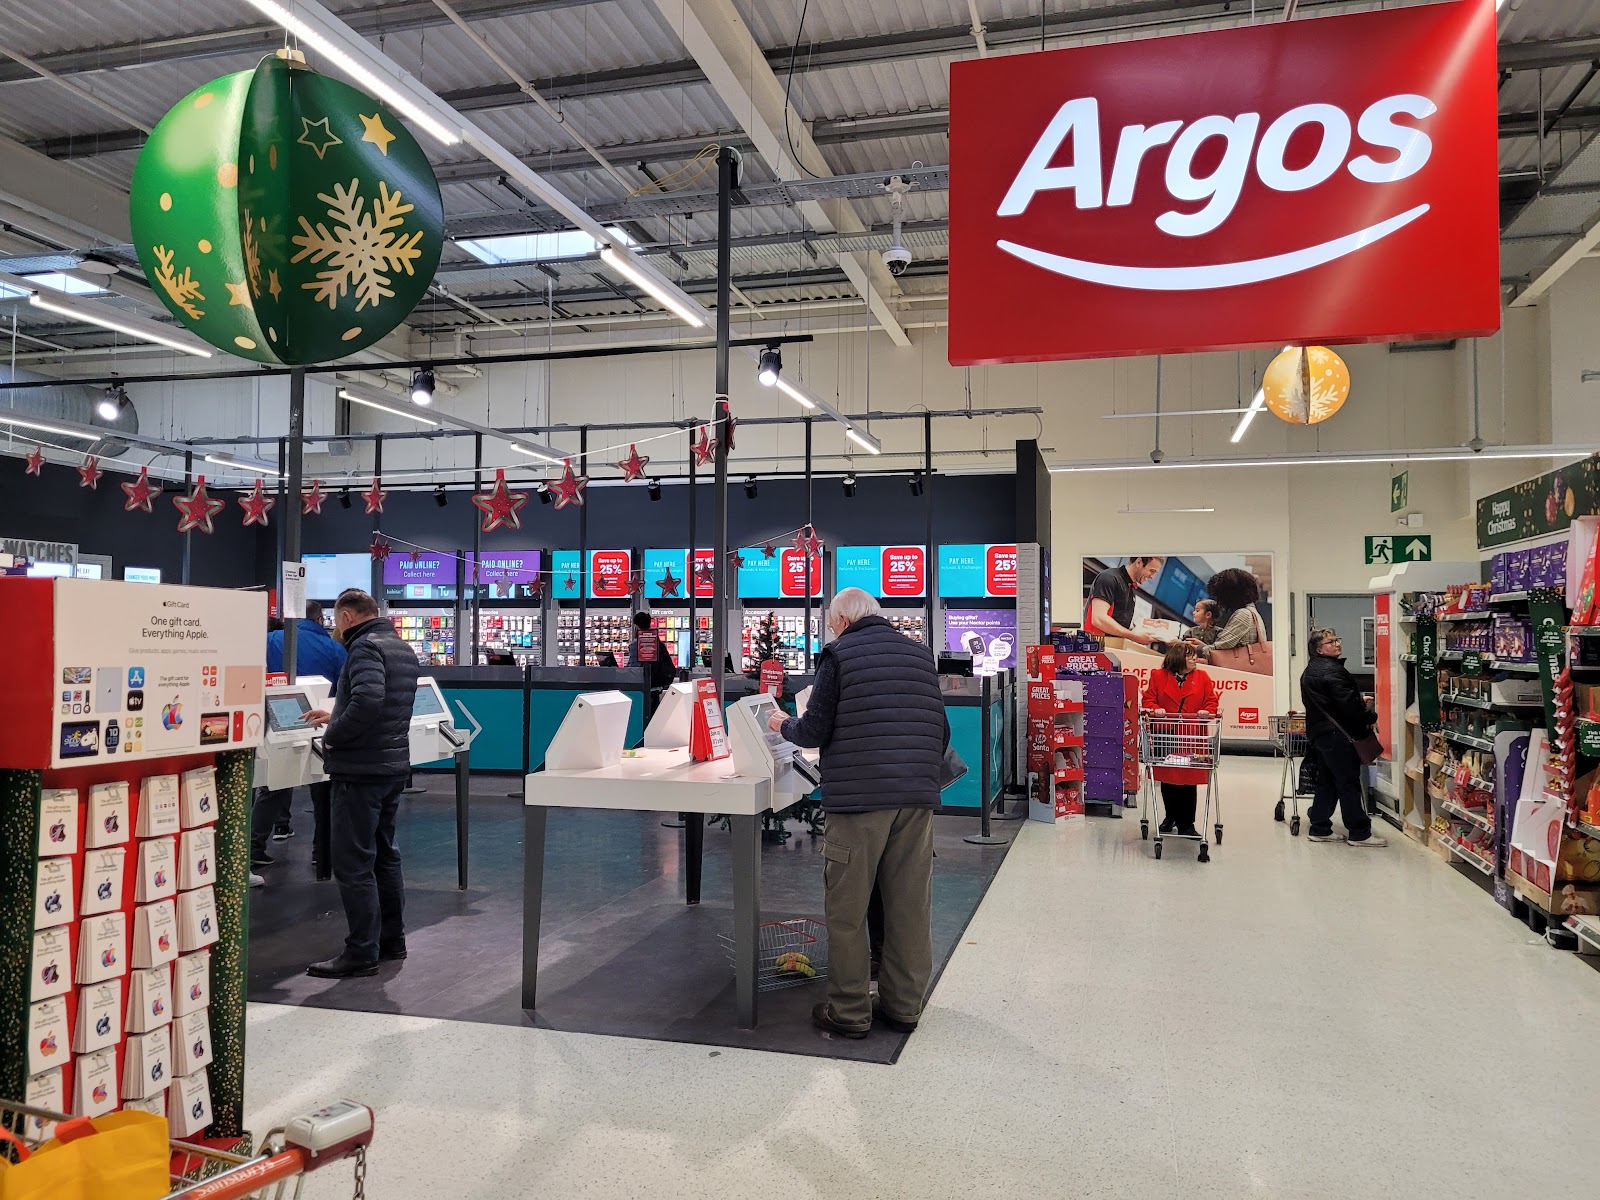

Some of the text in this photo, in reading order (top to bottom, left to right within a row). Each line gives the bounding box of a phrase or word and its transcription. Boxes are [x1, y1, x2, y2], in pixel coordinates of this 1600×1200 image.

[997, 94, 1438, 237] Argos
[1492, 500, 1510, 518] Happy
[1488, 518, 1516, 535] Christmas
[3, 539, 73, 563] WATCHES
[400, 560, 440, 570] PAID ONLINE?
[482, 559, 524, 568] PAID ONLINE?
[890, 561, 916, 572] 25%
[600, 564, 622, 575] 25%
[438, 586, 450, 597] Tu
[151, 616, 202, 628] One gift card.
[142, 628, 209, 640] Everything Apple.
[272, 678, 288, 687] offers
[1211, 680, 1248, 690] DUCTS
[109, 728, 118, 736] 10
[1032, 742, 1050, 752] Santa
